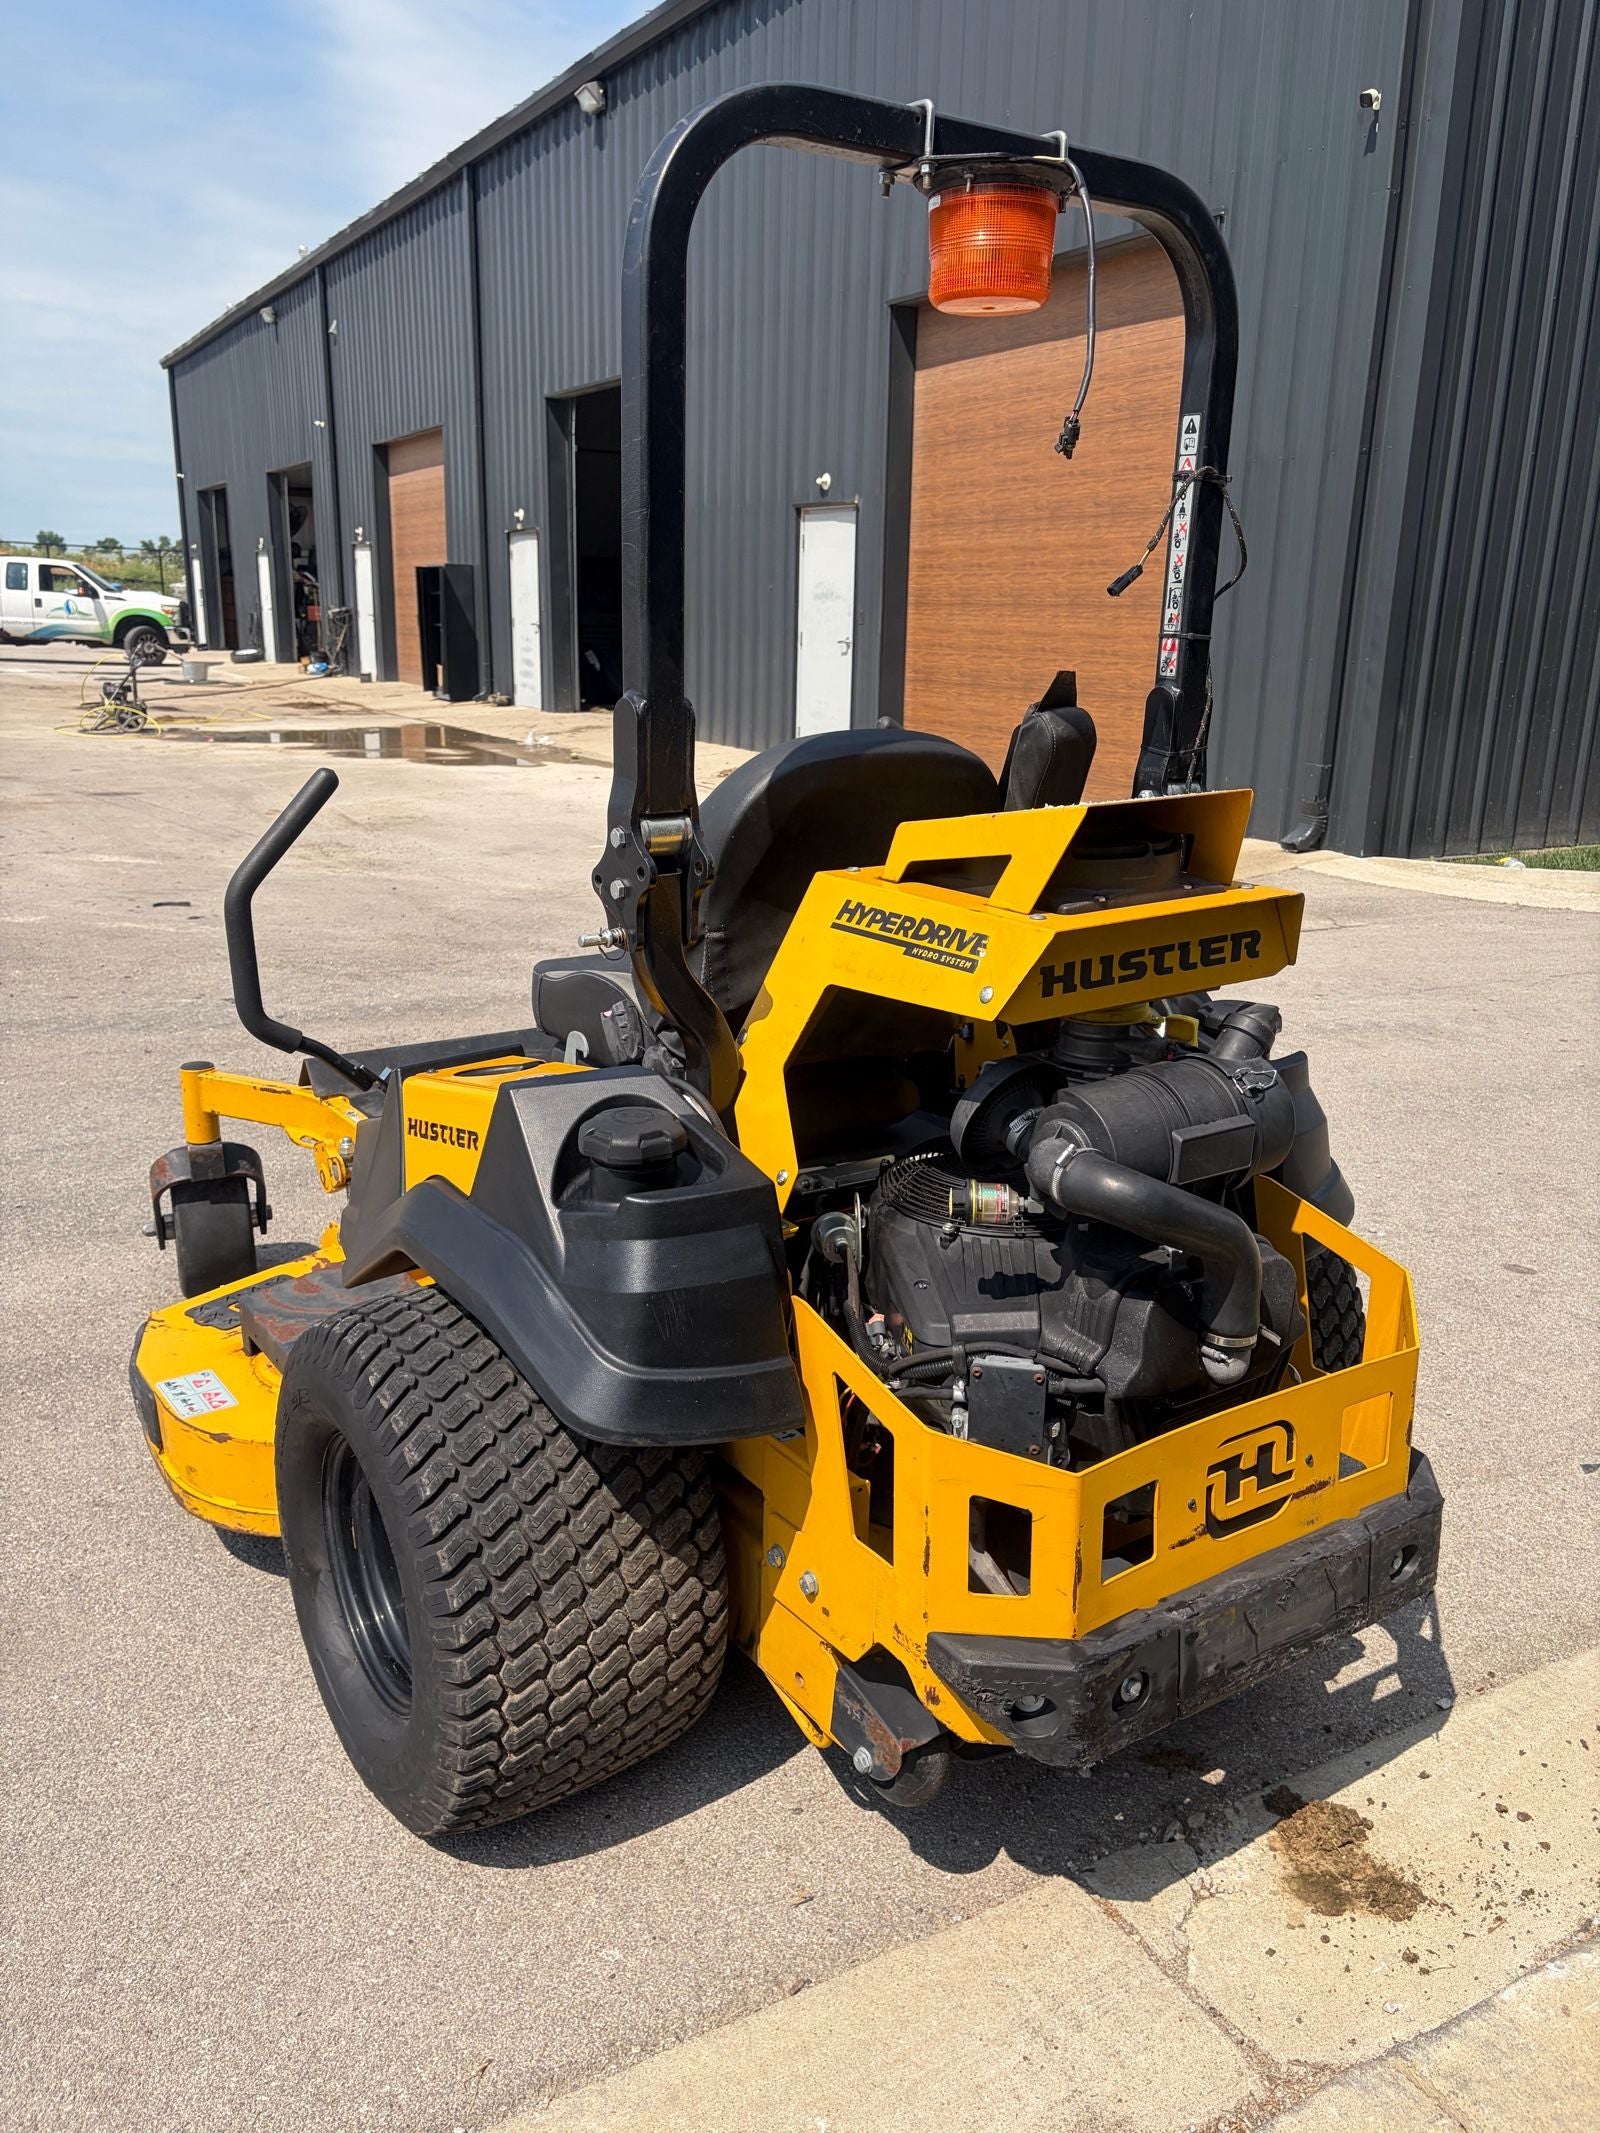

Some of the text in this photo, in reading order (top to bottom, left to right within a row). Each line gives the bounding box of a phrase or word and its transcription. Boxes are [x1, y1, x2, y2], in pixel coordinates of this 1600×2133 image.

[835, 899, 990, 957] HYPERDRIVE
[911, 947, 972, 969] HYDRO SYSTEM
[1040, 929, 1262, 998] HUSTLER
[407, 1117, 479, 1152] HUSTLER
